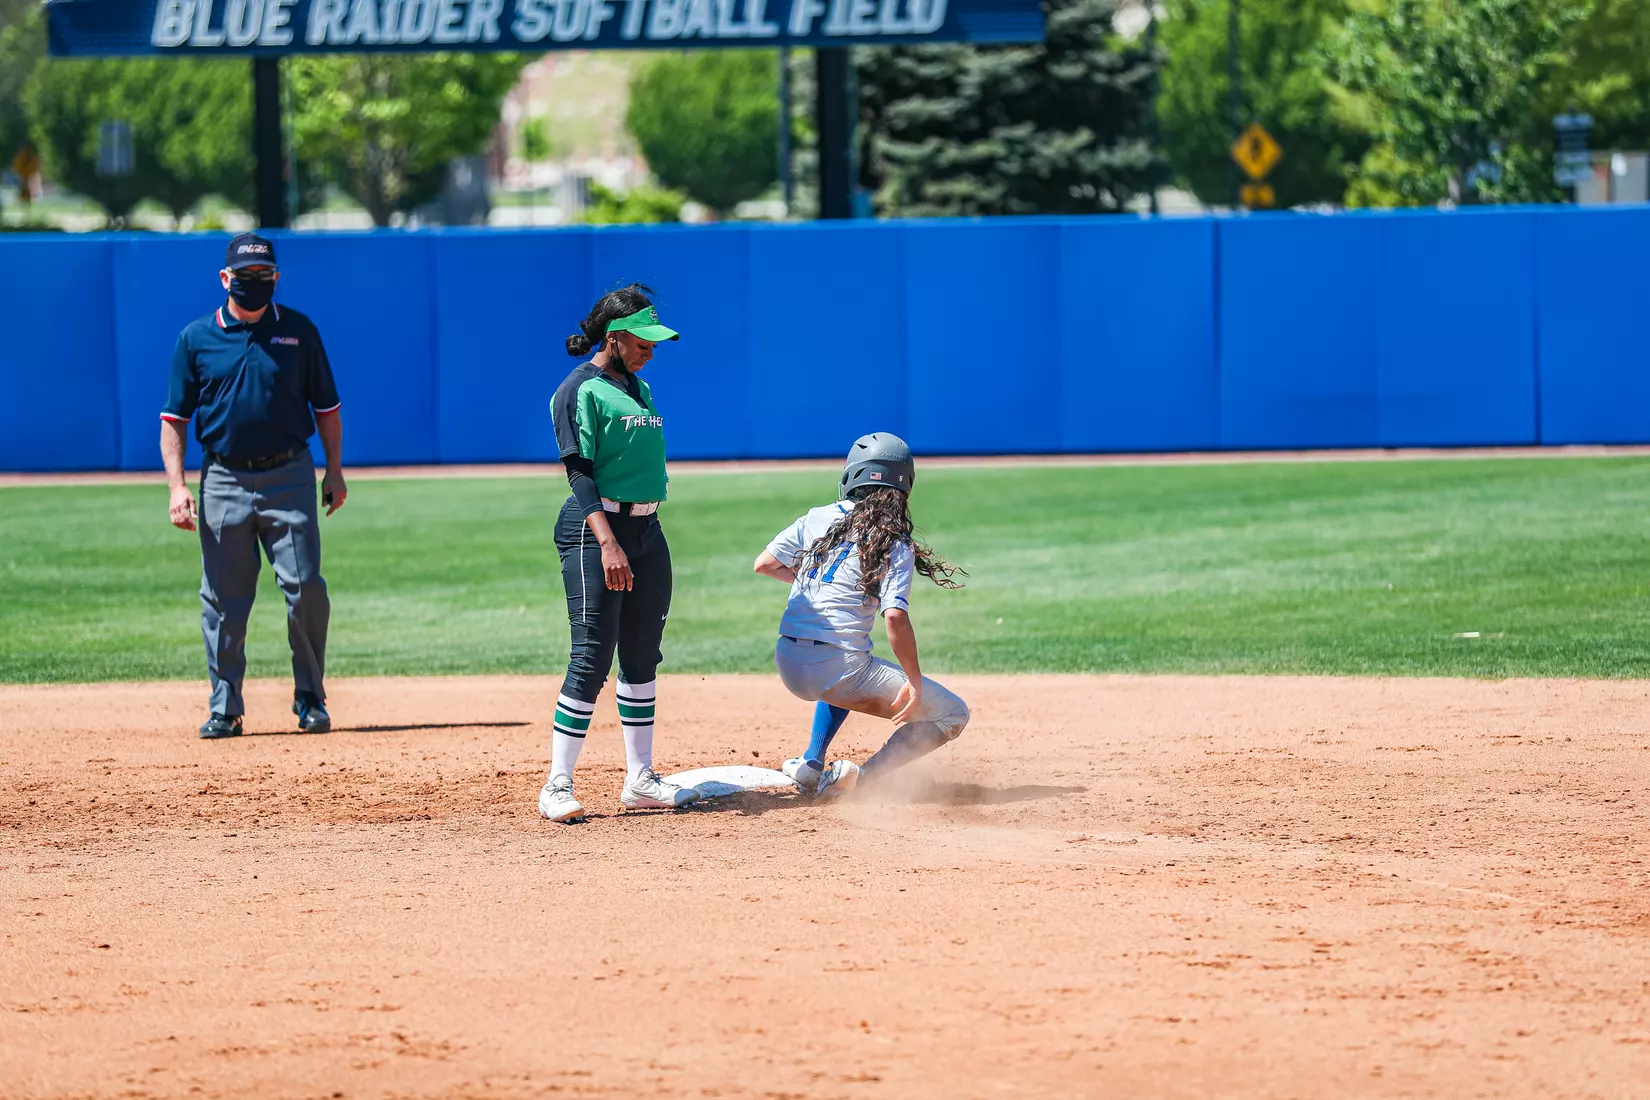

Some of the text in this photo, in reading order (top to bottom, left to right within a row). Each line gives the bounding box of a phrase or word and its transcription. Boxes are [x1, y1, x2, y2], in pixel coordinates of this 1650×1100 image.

[151, 0, 948, 47] BLUE RAIDER SOFTBALL FIELD
[619, 415, 663, 432] THE HE
